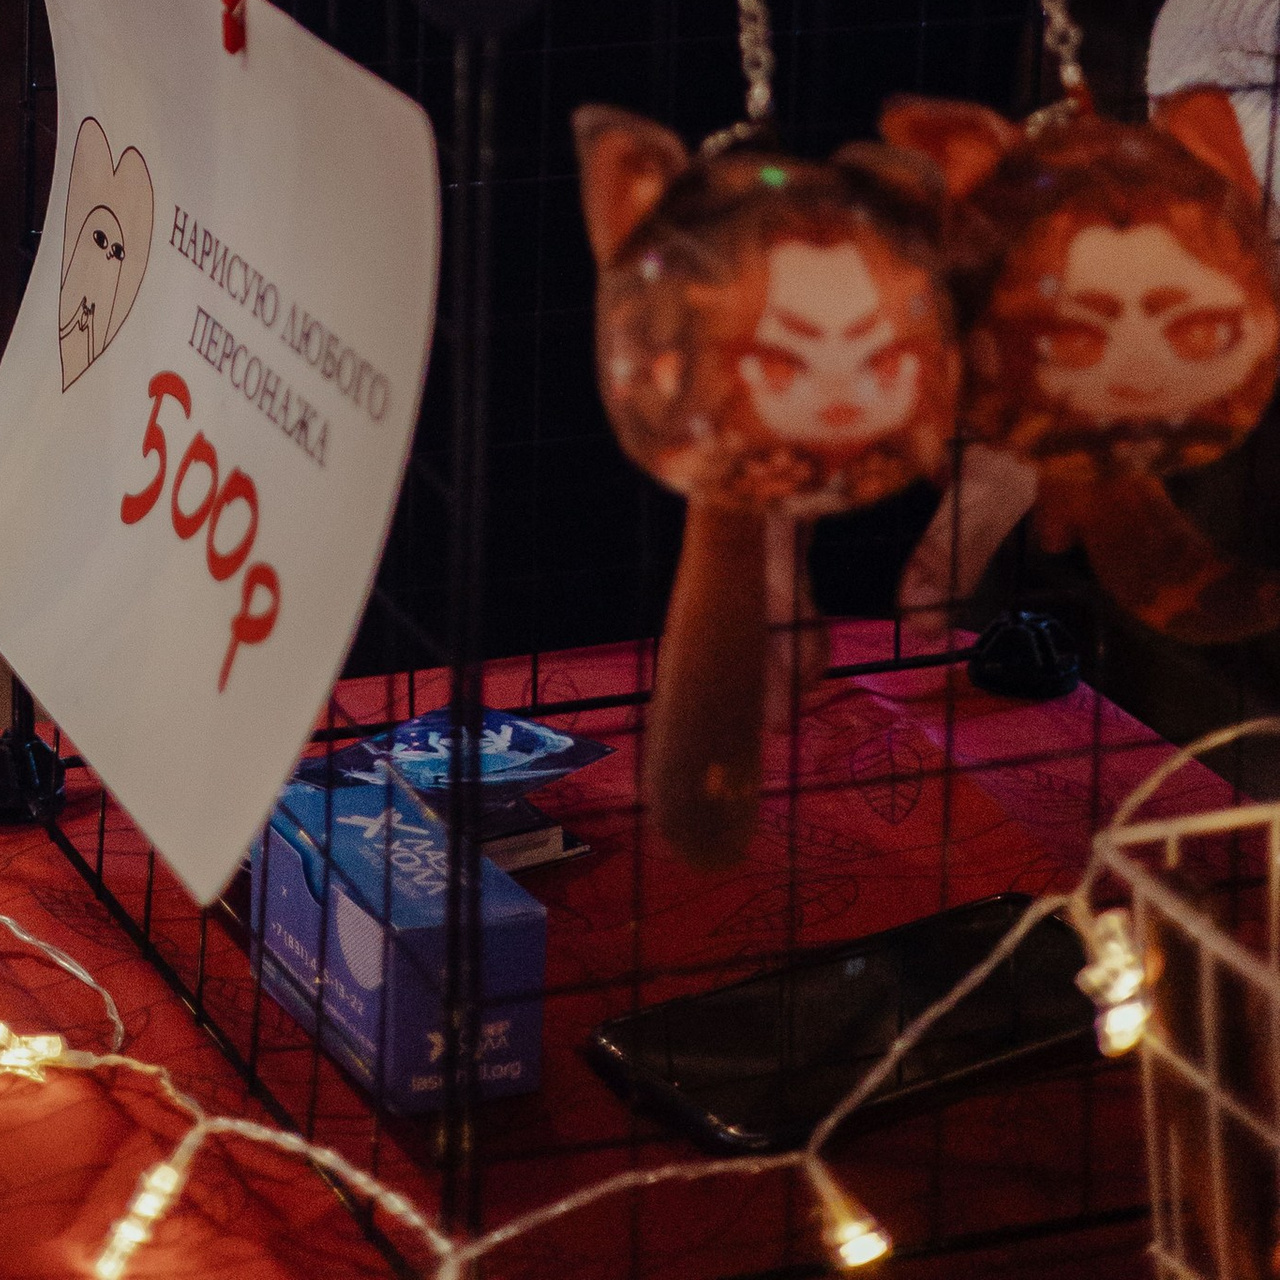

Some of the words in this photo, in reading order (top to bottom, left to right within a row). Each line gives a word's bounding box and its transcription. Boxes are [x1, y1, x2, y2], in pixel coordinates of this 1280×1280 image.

[169, 204, 280, 328] НАРИСУЮ
[280, 301, 391, 423] ЛЮБОГО
[188, 304, 331, 468] ПЕРСОНАЖА
